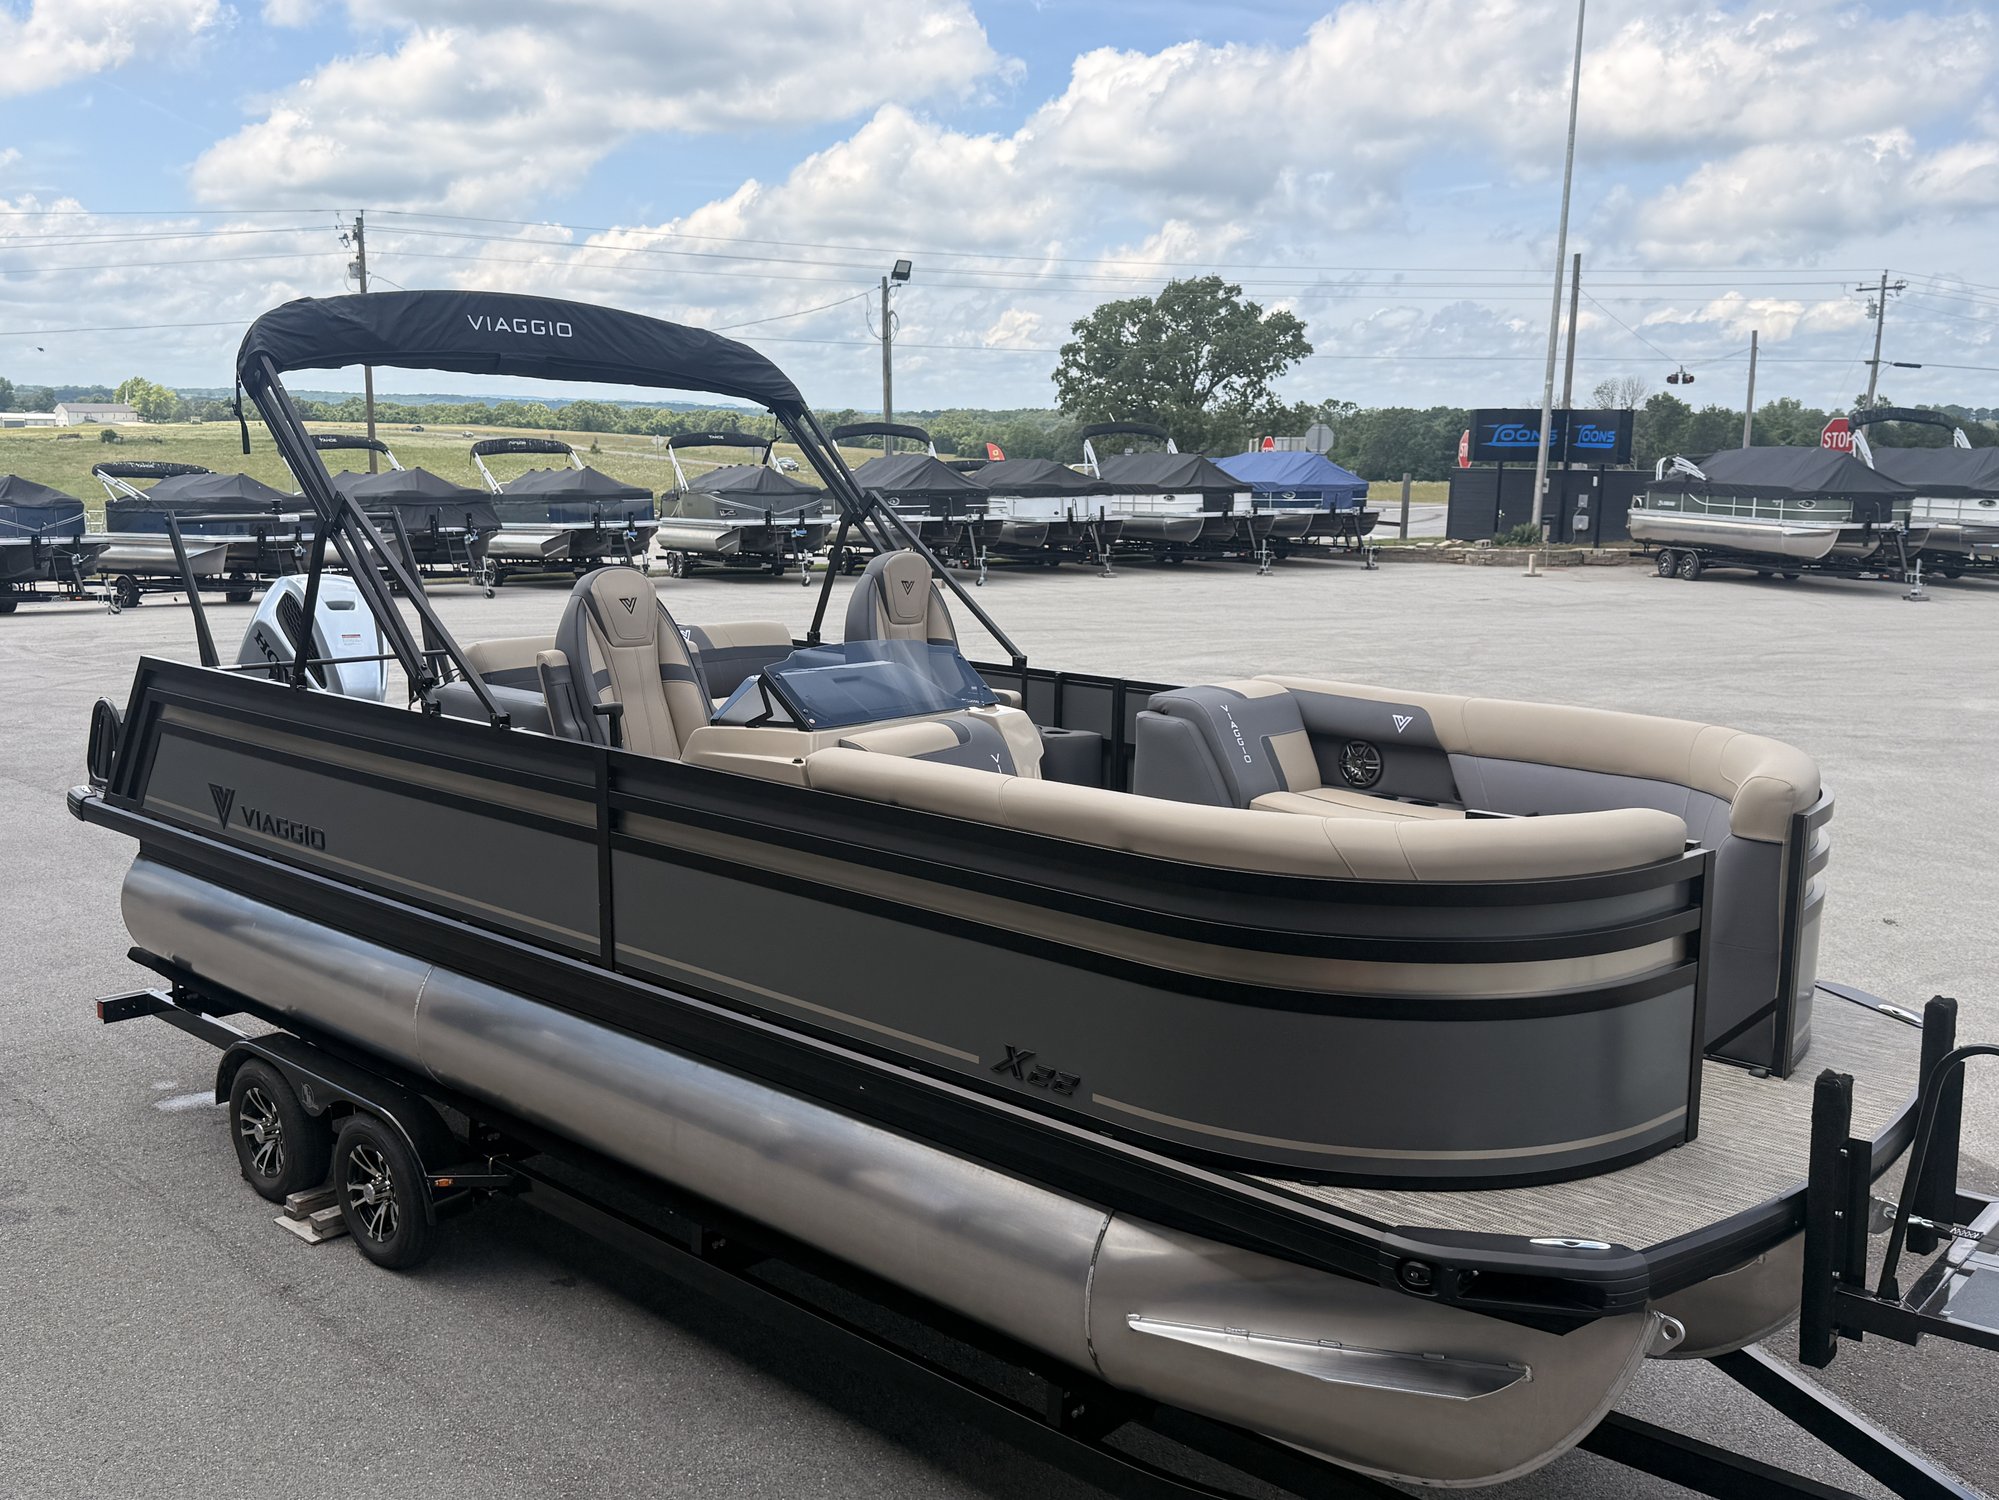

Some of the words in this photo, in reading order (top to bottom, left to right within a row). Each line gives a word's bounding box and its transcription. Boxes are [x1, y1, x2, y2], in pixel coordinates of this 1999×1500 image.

[467, 314, 573, 337] VIAGGIO
[1220, 704, 1252, 763] VIAGGIO
[240, 805, 326, 850] VIAGGIO
[990, 1043, 1081, 1095] X22
